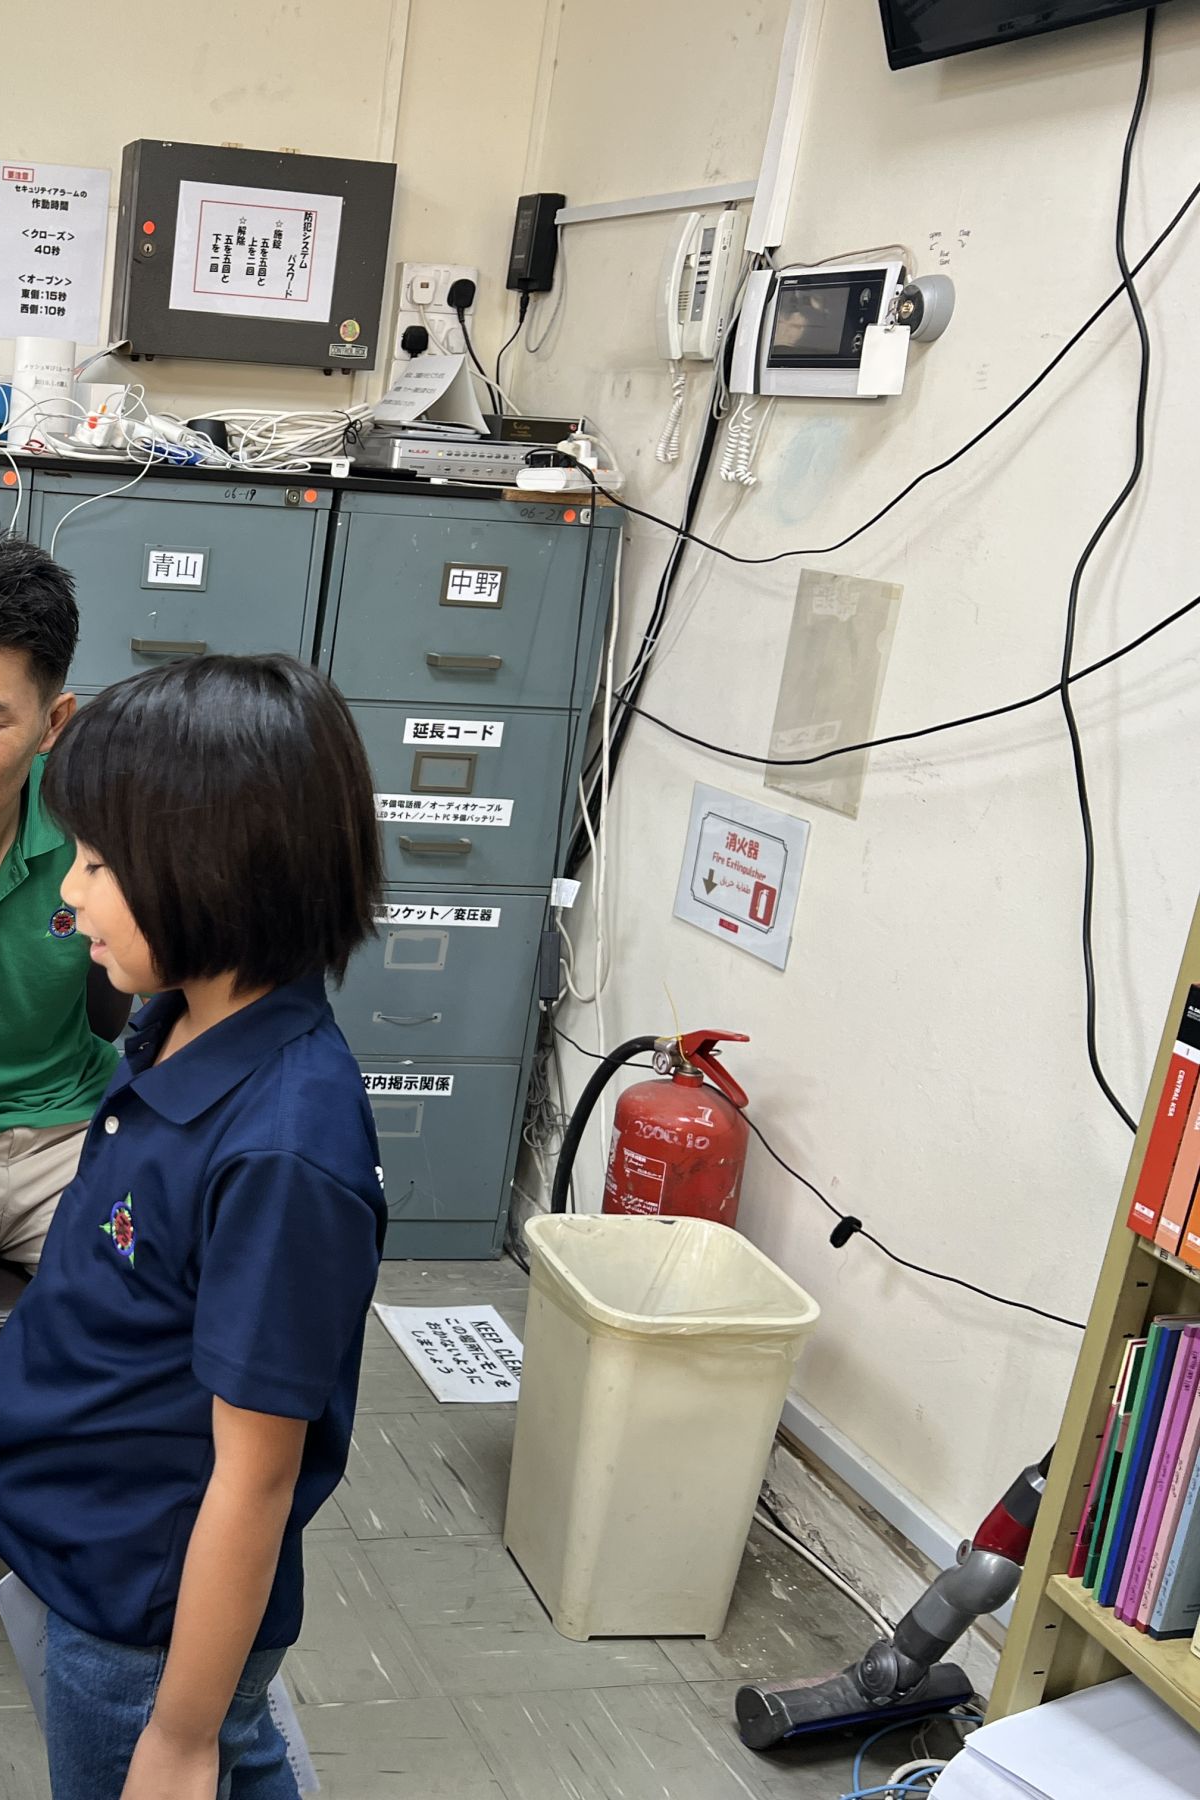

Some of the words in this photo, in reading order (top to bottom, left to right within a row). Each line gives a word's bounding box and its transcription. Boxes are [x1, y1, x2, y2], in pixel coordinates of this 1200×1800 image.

[14, 184, 88, 199] セキュリティアラームの
[31, 198, 69, 211] 作動時間
[34, 244, 61, 256] 40秒
[236, 226, 247, 246] 解除
[272, 229, 283, 250] 施錠
[299, 211, 314, 269] 防犯システム
[209, 233, 222, 273] 下を一回
[221, 234, 233, 284] 五を五回と
[245, 237, 258, 276] 上を二回
[257, 238, 270, 286] 五を五回と
[285, 254, 296, 299] パスワード
[151, 553, 198, 579] 青山
[451, 570, 499, 597] 中野
[412, 722, 495, 741] 延長コード
[725, 831, 760, 861] 消火器
[712, 851, 726, 867] Fire
[725, 857, 767, 882] Extinguisher
[470, 1320, 504, 1346] KEEP
[411, 1330, 453, 1374] しましょう
[425, 1321, 484, 1385] おかないように
[445, 1318, 512, 1388] この場所にモノを
